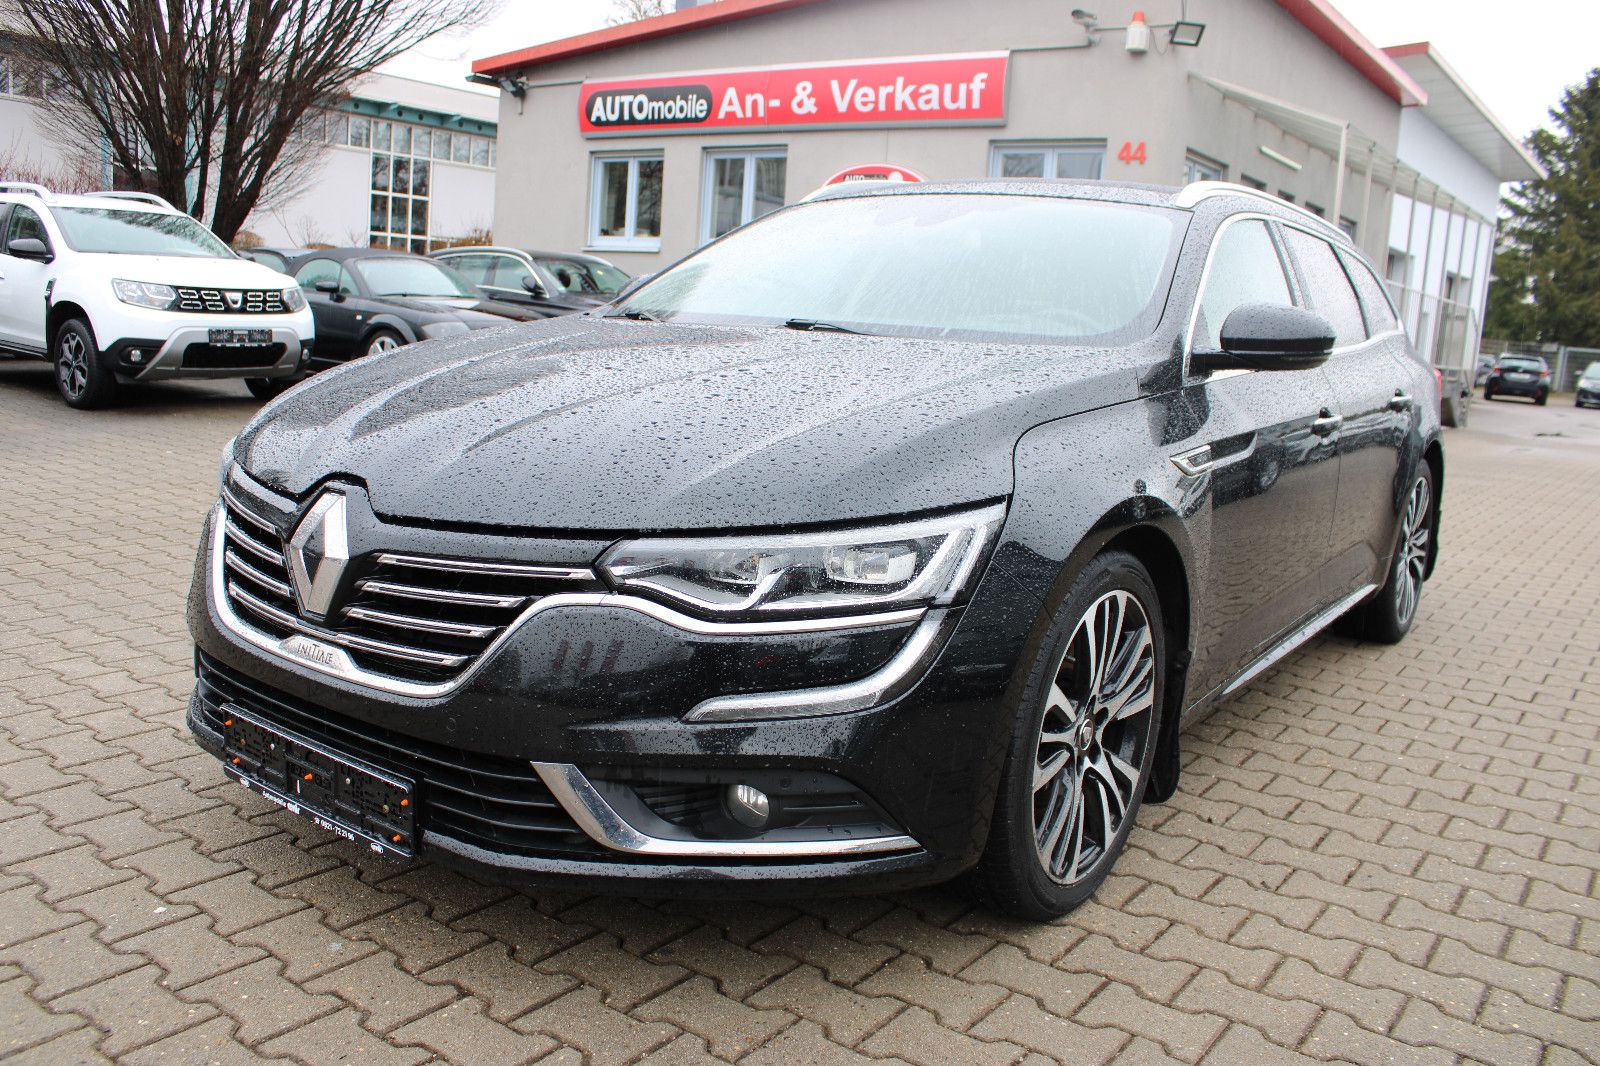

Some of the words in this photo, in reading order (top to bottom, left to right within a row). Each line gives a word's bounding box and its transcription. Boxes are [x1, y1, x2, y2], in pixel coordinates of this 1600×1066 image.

[590, 94, 708, 122] AUTOmobile
[717, 86, 781, 119] An-
[790, 80, 818, 115] &
[830, 72, 988, 113] Verkauf
[1117, 142, 1146, 165] 44
